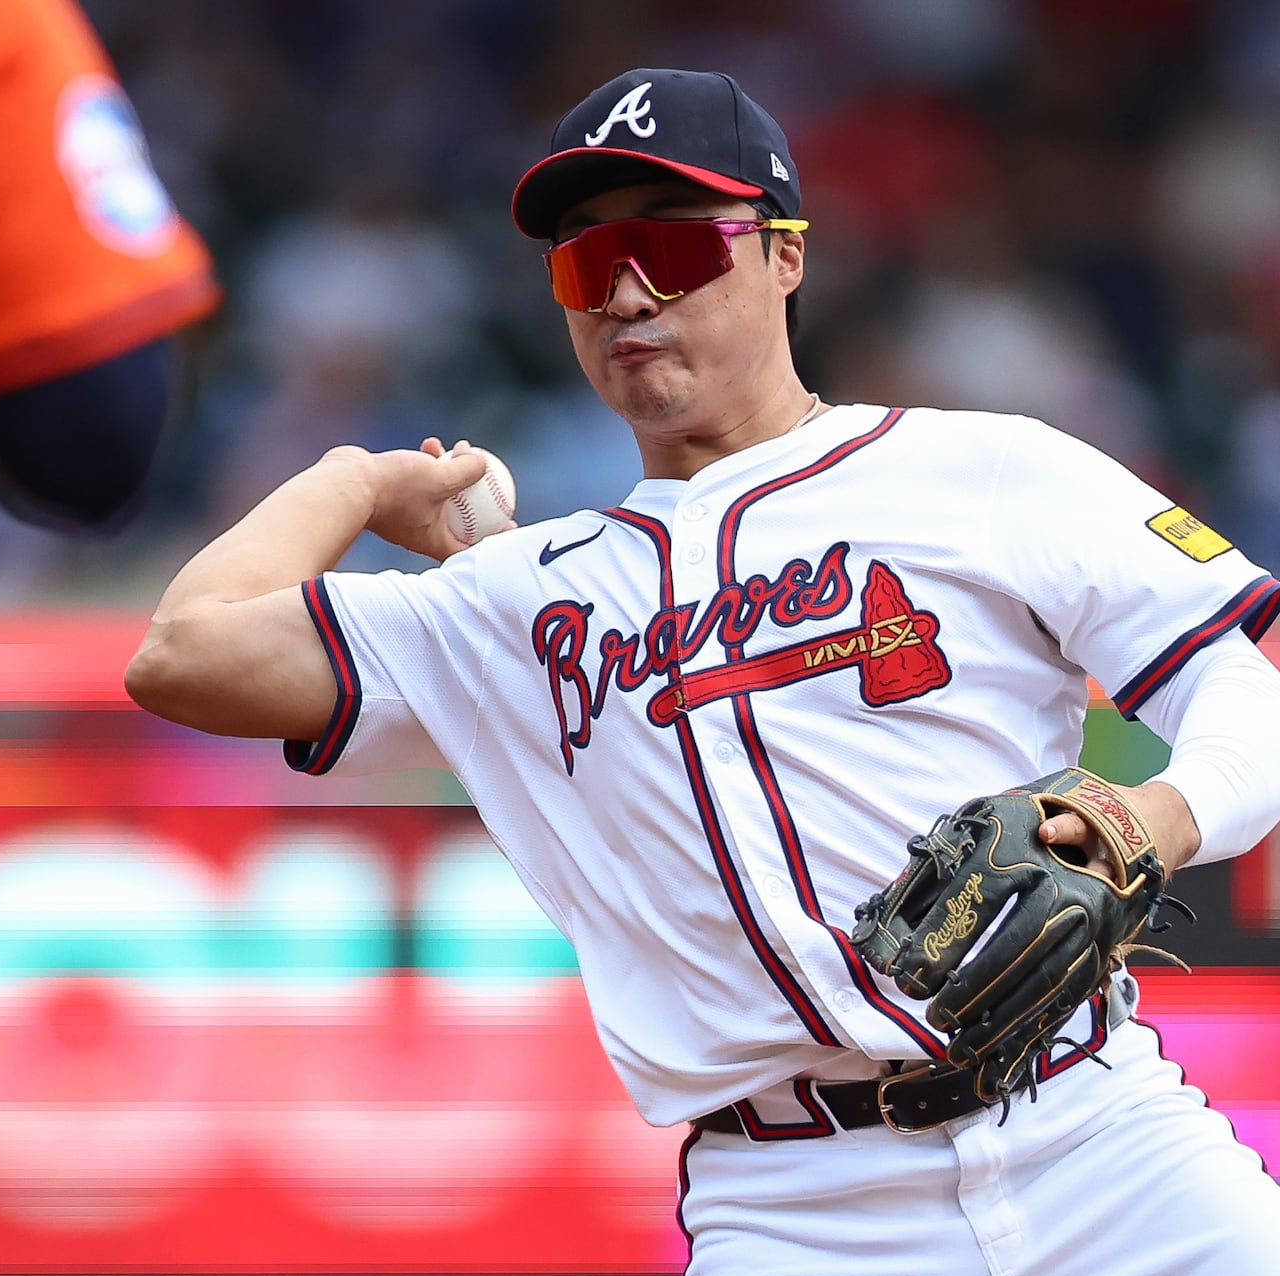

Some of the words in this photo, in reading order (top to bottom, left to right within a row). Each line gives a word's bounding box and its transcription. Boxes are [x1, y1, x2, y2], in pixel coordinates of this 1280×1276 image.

[585, 82, 657, 147] A
[532, 541, 851, 777] Braves
[923, 872, 984, 952] Rawlings
